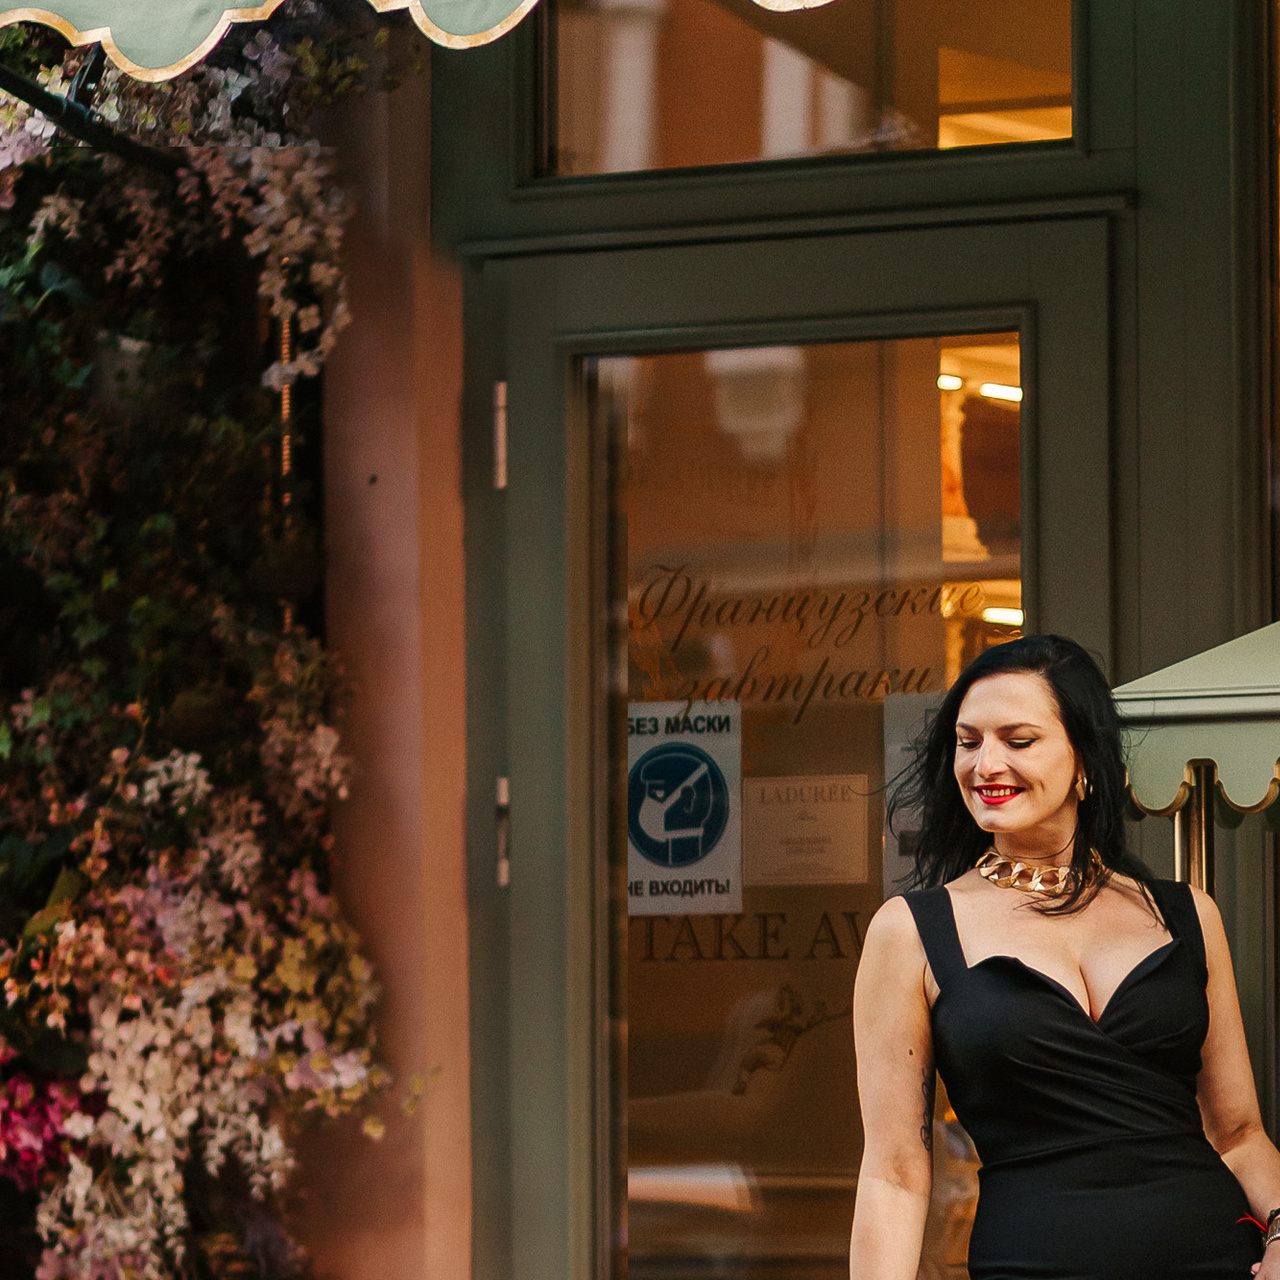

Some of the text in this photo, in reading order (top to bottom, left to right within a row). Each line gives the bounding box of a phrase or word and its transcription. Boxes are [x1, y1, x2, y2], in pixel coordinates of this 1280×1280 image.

[629, 564, 985, 653] Французские
[674, 645, 937, 726] завтраки
[664, 714, 731, 735] МАСКИ
[649, 878, 731, 899] ВХОДИТЬ!
[629, 911, 790, 962] TAKE
